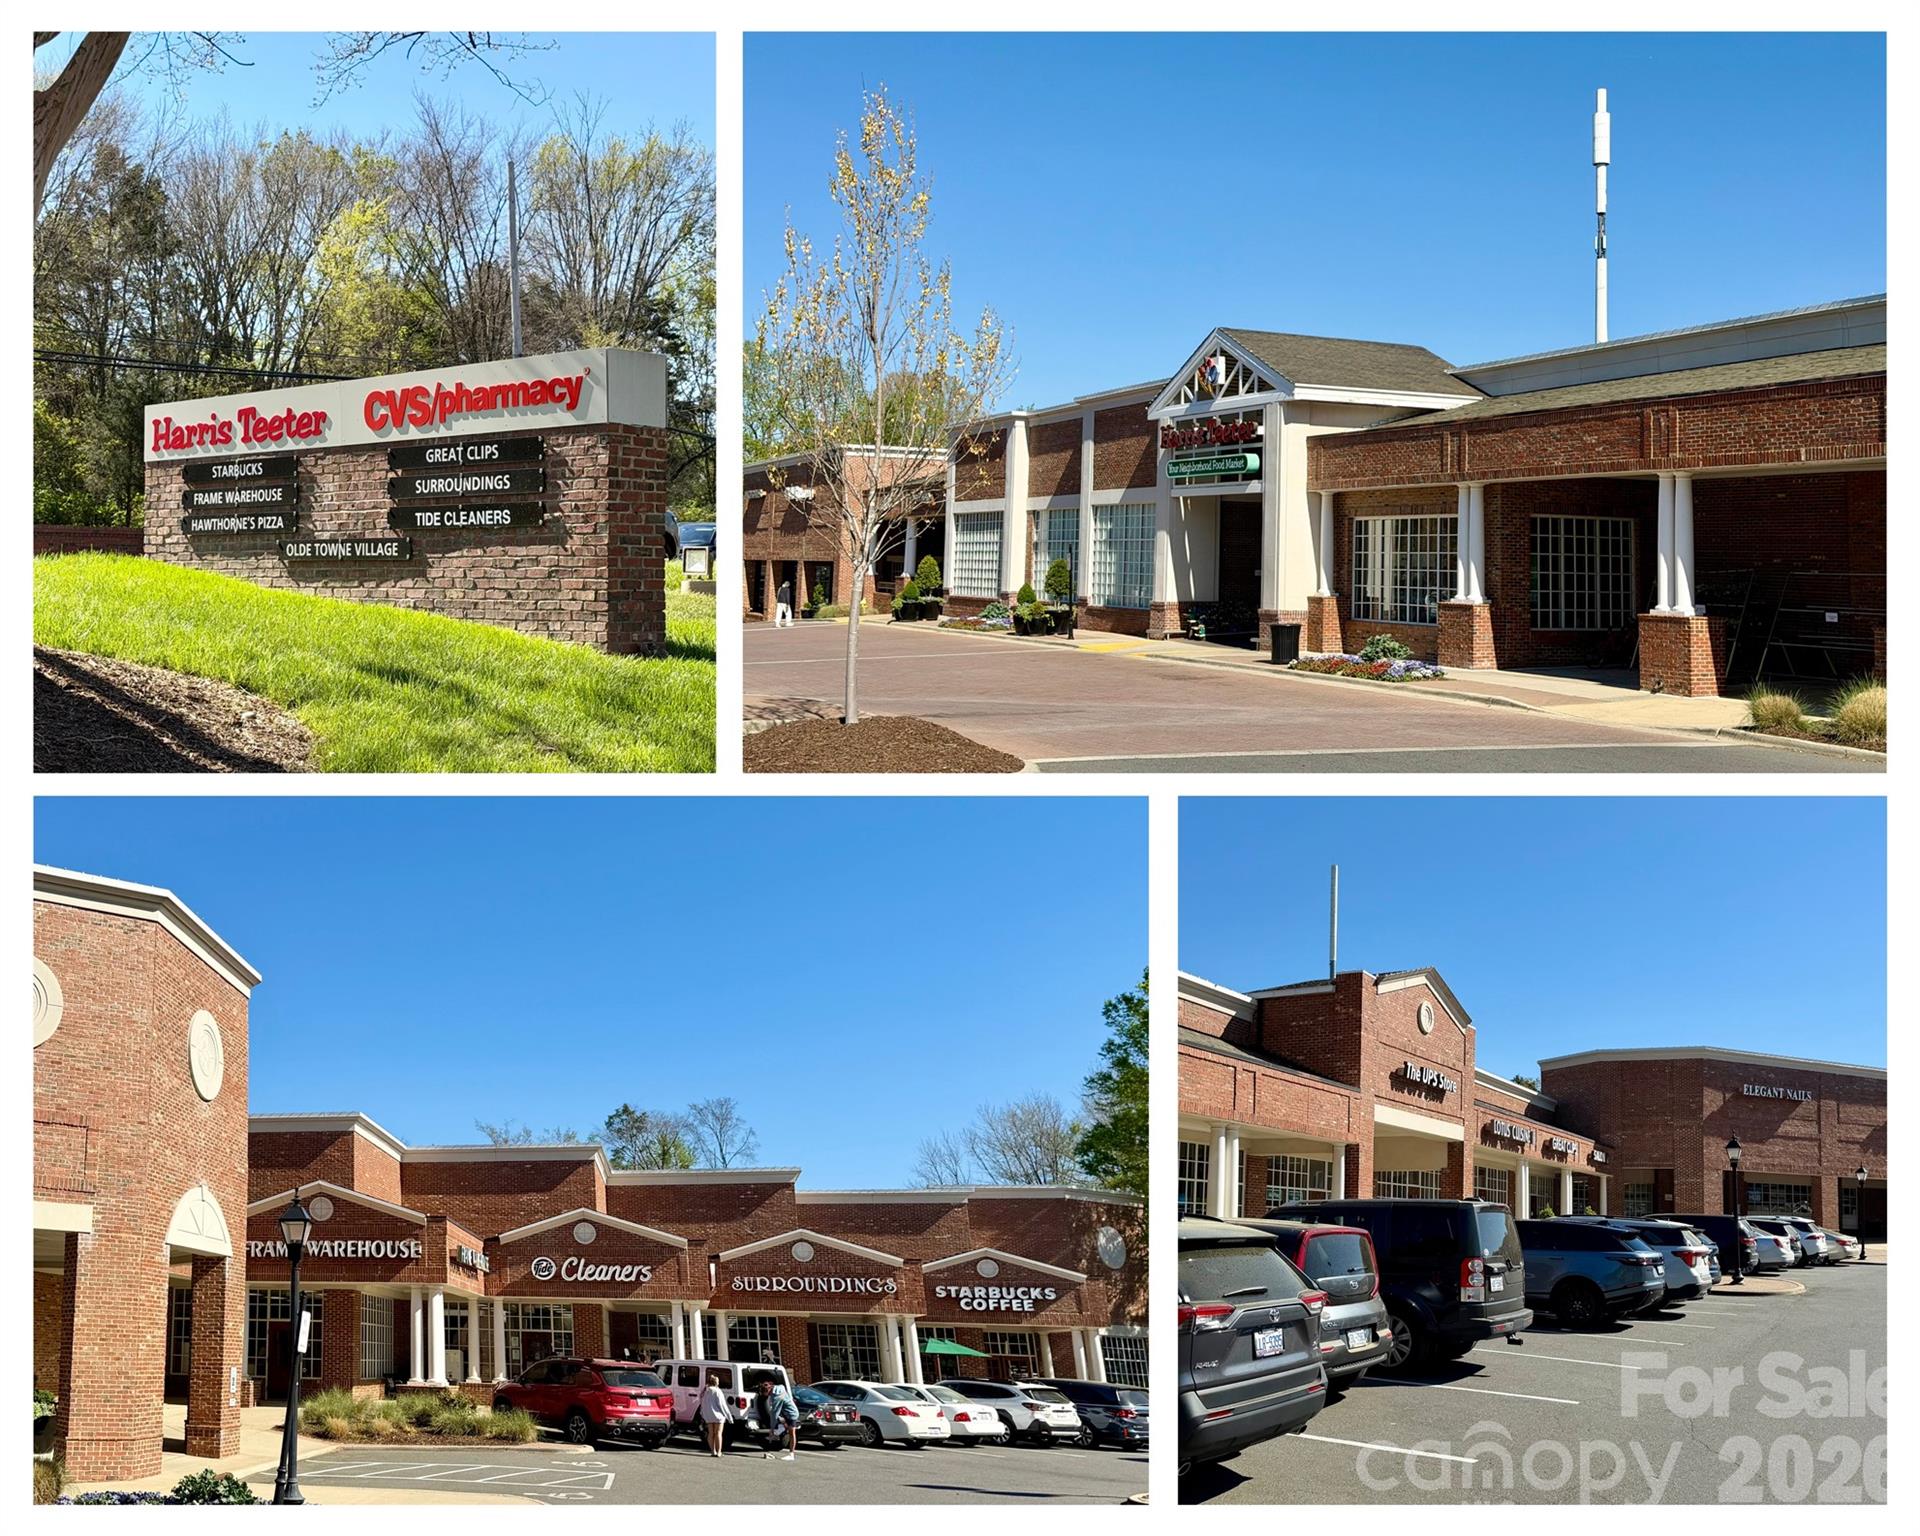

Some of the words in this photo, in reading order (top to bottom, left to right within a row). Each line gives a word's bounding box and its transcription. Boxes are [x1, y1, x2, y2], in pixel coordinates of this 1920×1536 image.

[364, 375, 583, 431] CVS/pharmacy
[152, 413, 232, 452] Harris
[237, 406, 327, 444] Teeter
[425, 448, 463, 463] GREAT
[467, 444, 499, 460] CLIPS
[212, 463, 263, 479] STARBUCKS
[415, 474, 511, 494] SURROUNDINGS
[193, 493, 224, 506] FRAME
[225, 487, 283, 504] WAREHOUSE
[191, 518, 255, 532] HAWTHORNE'S
[257, 515, 284, 529] PIZZA
[415, 512, 441, 526] TIDE
[443, 509, 511, 525] CLEANERS
[286, 543, 312, 557] OLDE
[314, 542, 352, 557] TOWNE
[354, 542, 399, 556] VILLAGE
[1406, 1061, 1421, 1081] The
[1422, 1067, 1438, 1087] UPS
[1439, 1073, 1457, 1093] Store
[1743, 1083, 1784, 1099] ELEGANT
[1786, 1088, 1812, 1101] NAILS
[306, 1240, 422, 1259] WAREHOUSE
[533, 1261, 554, 1276] Tide
[561, 1256, 653, 1282] Cleaners
[732, 1276, 897, 1293] SURROUNDINGS
[935, 1285, 1057, 1300] STARBUCKS
[960, 1298, 1035, 1312] COFFEE
